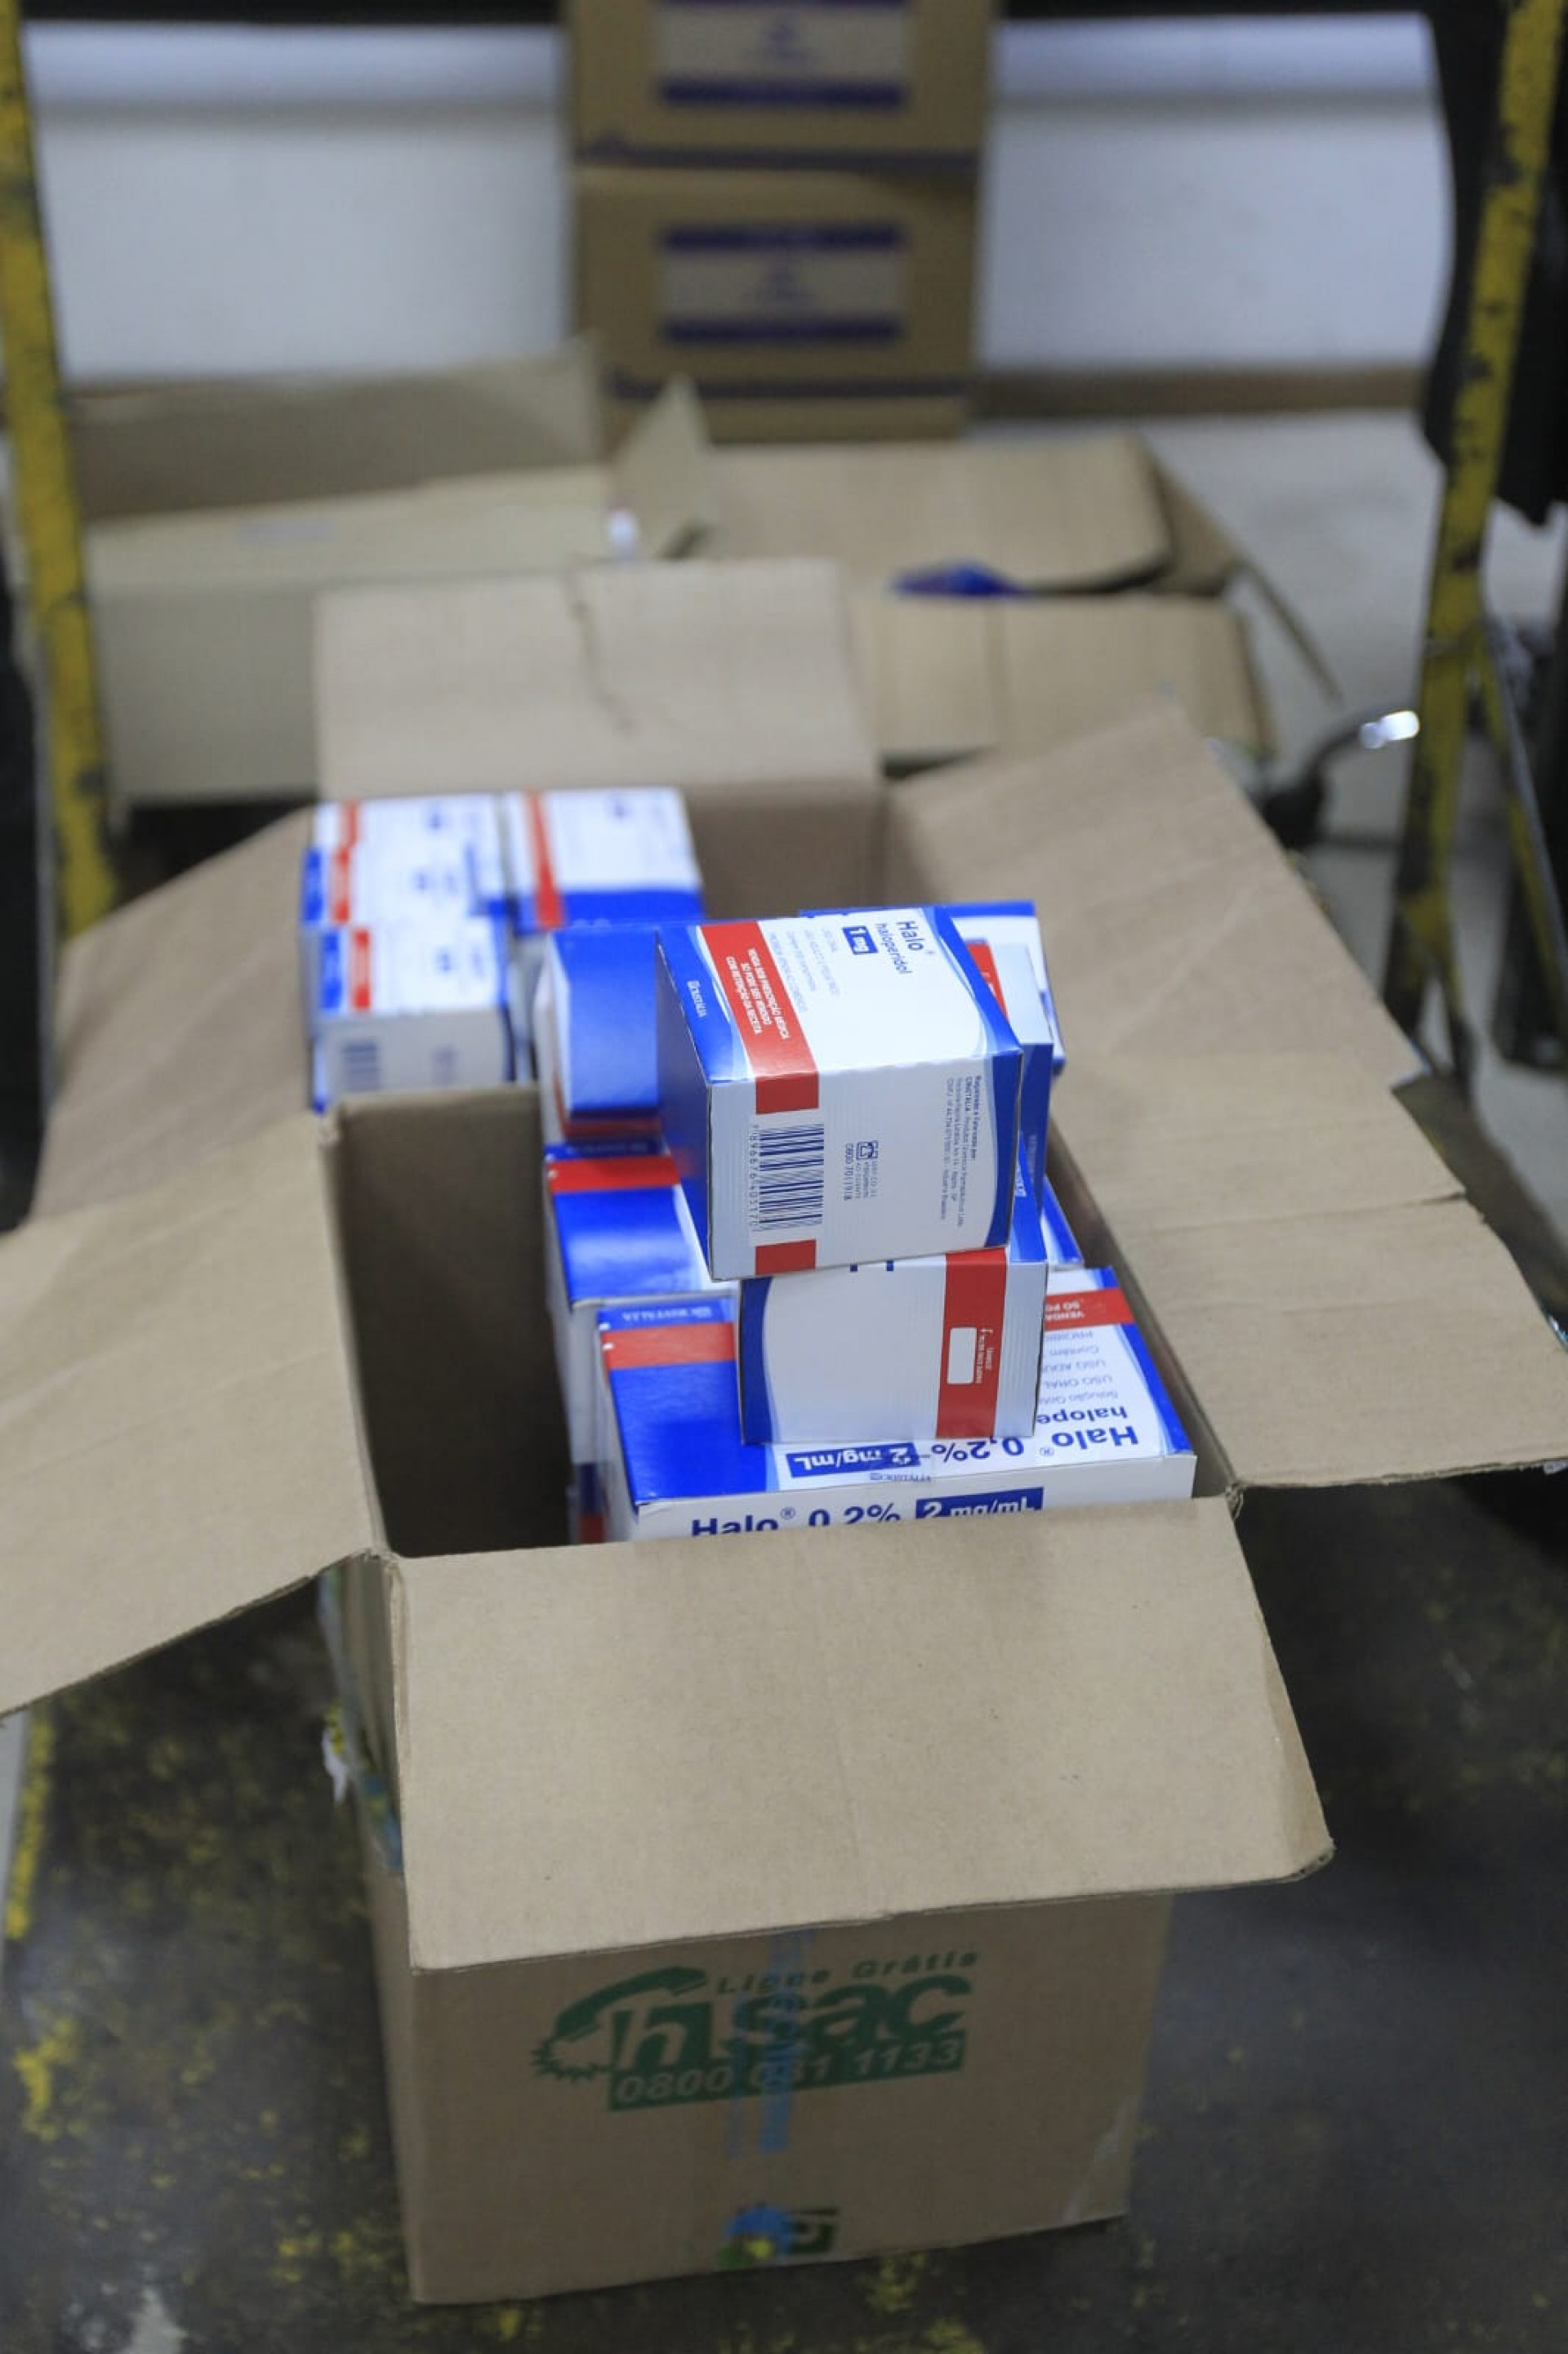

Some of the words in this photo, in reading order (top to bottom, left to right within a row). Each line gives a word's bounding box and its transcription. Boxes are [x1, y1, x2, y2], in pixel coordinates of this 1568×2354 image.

[852, 936, 870, 953] mg
[875, 923, 913, 974] haloperidol
[1082, 1374, 1113, 1386] USO
[794, 1448, 883, 1471] mg/mL
[889, 1447, 912, 1465] 2
[932, 1435, 1025, 1462] 0,2%
[853, 1950, 979, 1978] Grátis
[616, 2066, 731, 2104] 0800
[853, 2038, 963, 2075] 1133
